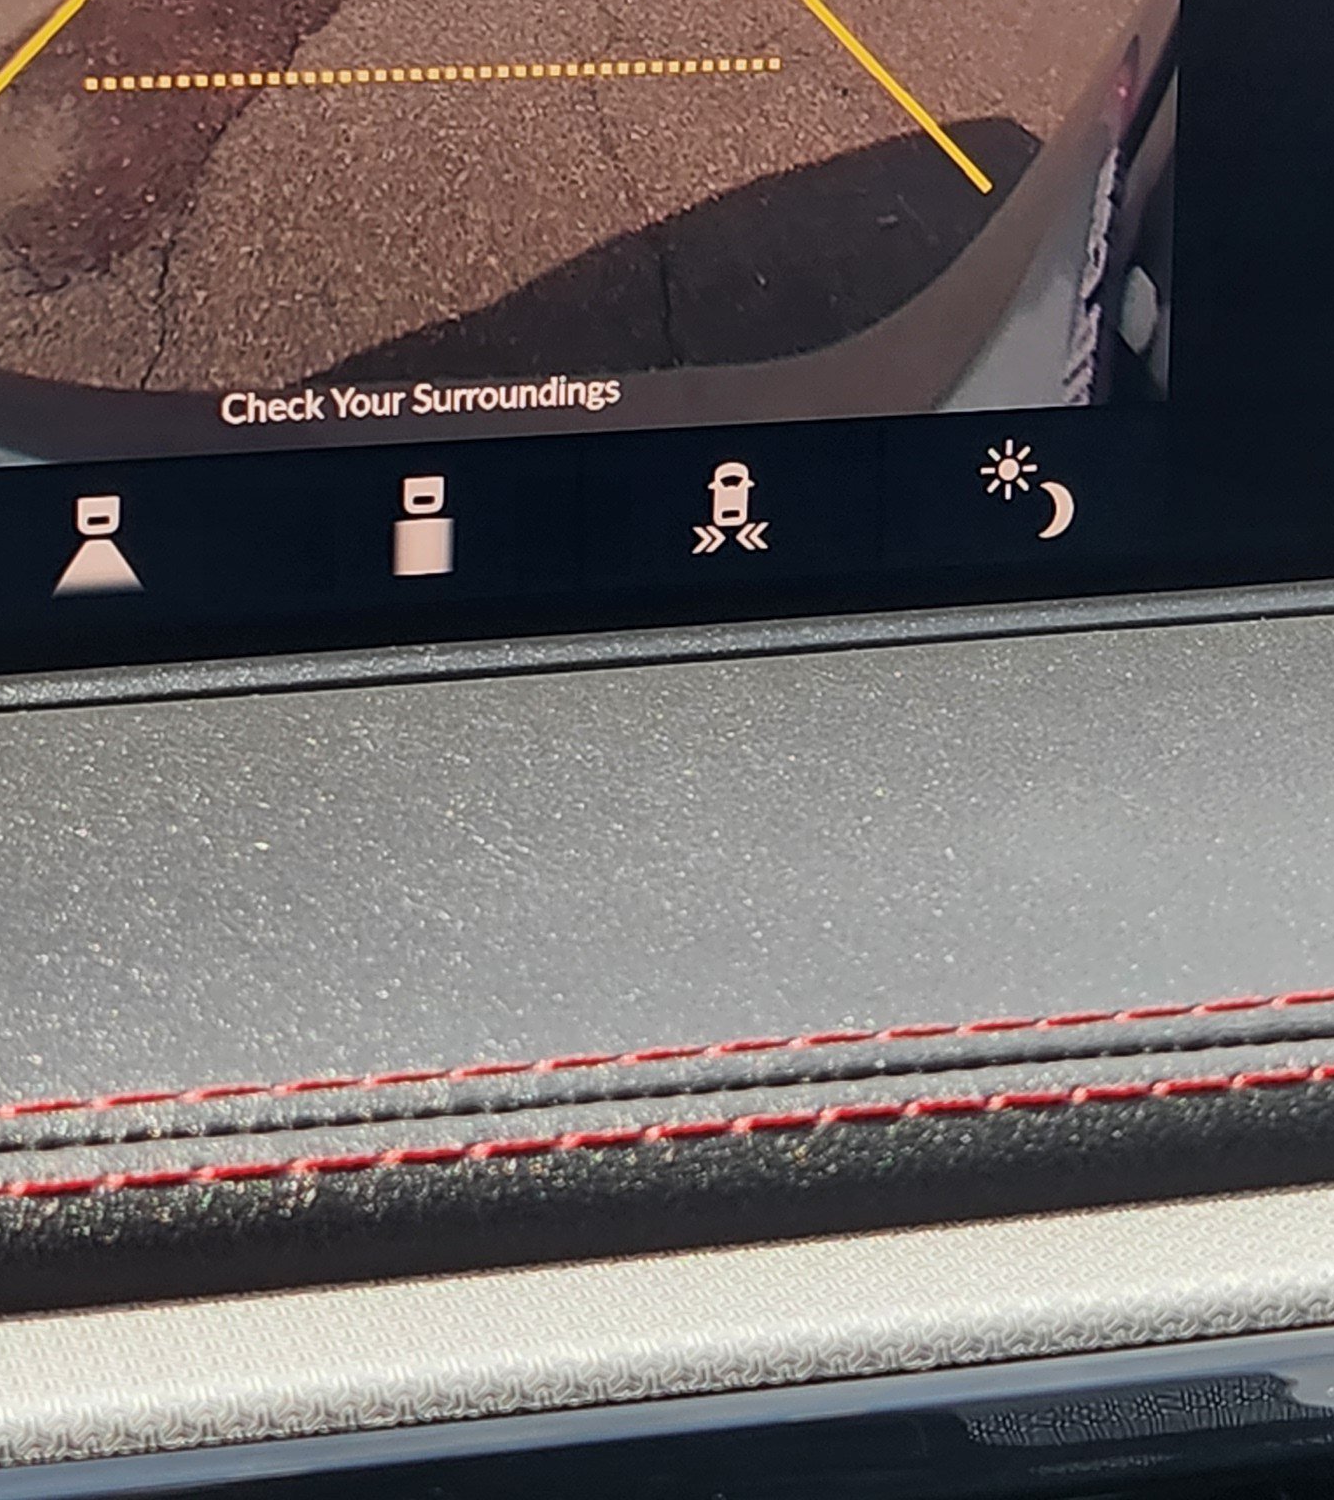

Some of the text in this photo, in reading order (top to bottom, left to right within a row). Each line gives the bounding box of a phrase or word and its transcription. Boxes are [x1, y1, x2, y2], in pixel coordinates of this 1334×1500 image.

[221, 374, 622, 425] Check Your Surroundings
